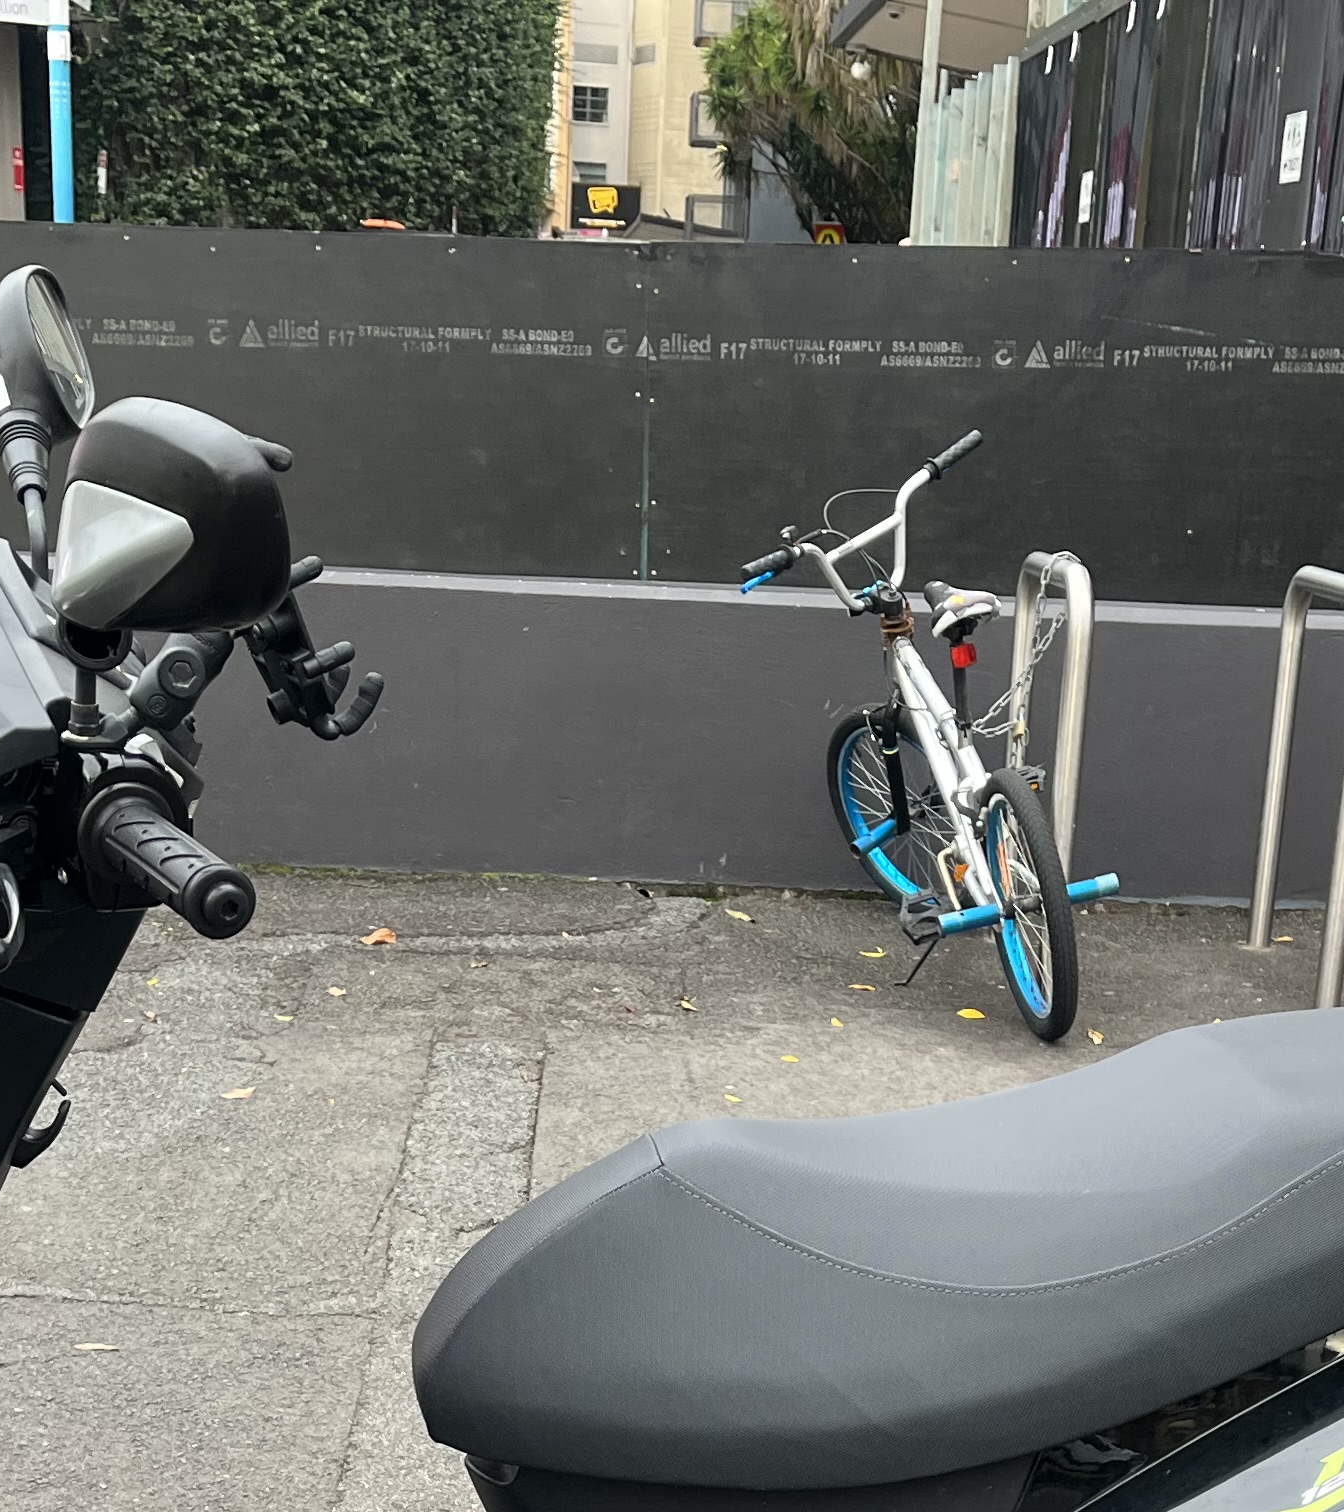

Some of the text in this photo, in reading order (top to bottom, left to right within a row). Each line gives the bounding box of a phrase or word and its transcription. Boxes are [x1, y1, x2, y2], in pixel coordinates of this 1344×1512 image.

[267, 318, 319, 341] allied
[358, 324, 492, 341] STRUCTURAL FORMPLY
[501, 328, 526, 342] SS-A
[328, 329, 355, 348] F17
[660, 332, 711, 353] allied
[749, 337, 882, 353] STRUCTURAL FORMPLY
[892, 340, 916, 353] SS-A
[720, 342, 747, 360] F17
[1053, 339, 1105, 360] allied
[1113, 348, 1140, 367] F17
[1143, 345, 1275, 359] STRUCTURAL FORMPLY
[1284, 347, 1309, 359] SS-A
[793, 352, 841, 365] 17-10-11
[1185, 359, 1233, 372] 17-10-11
